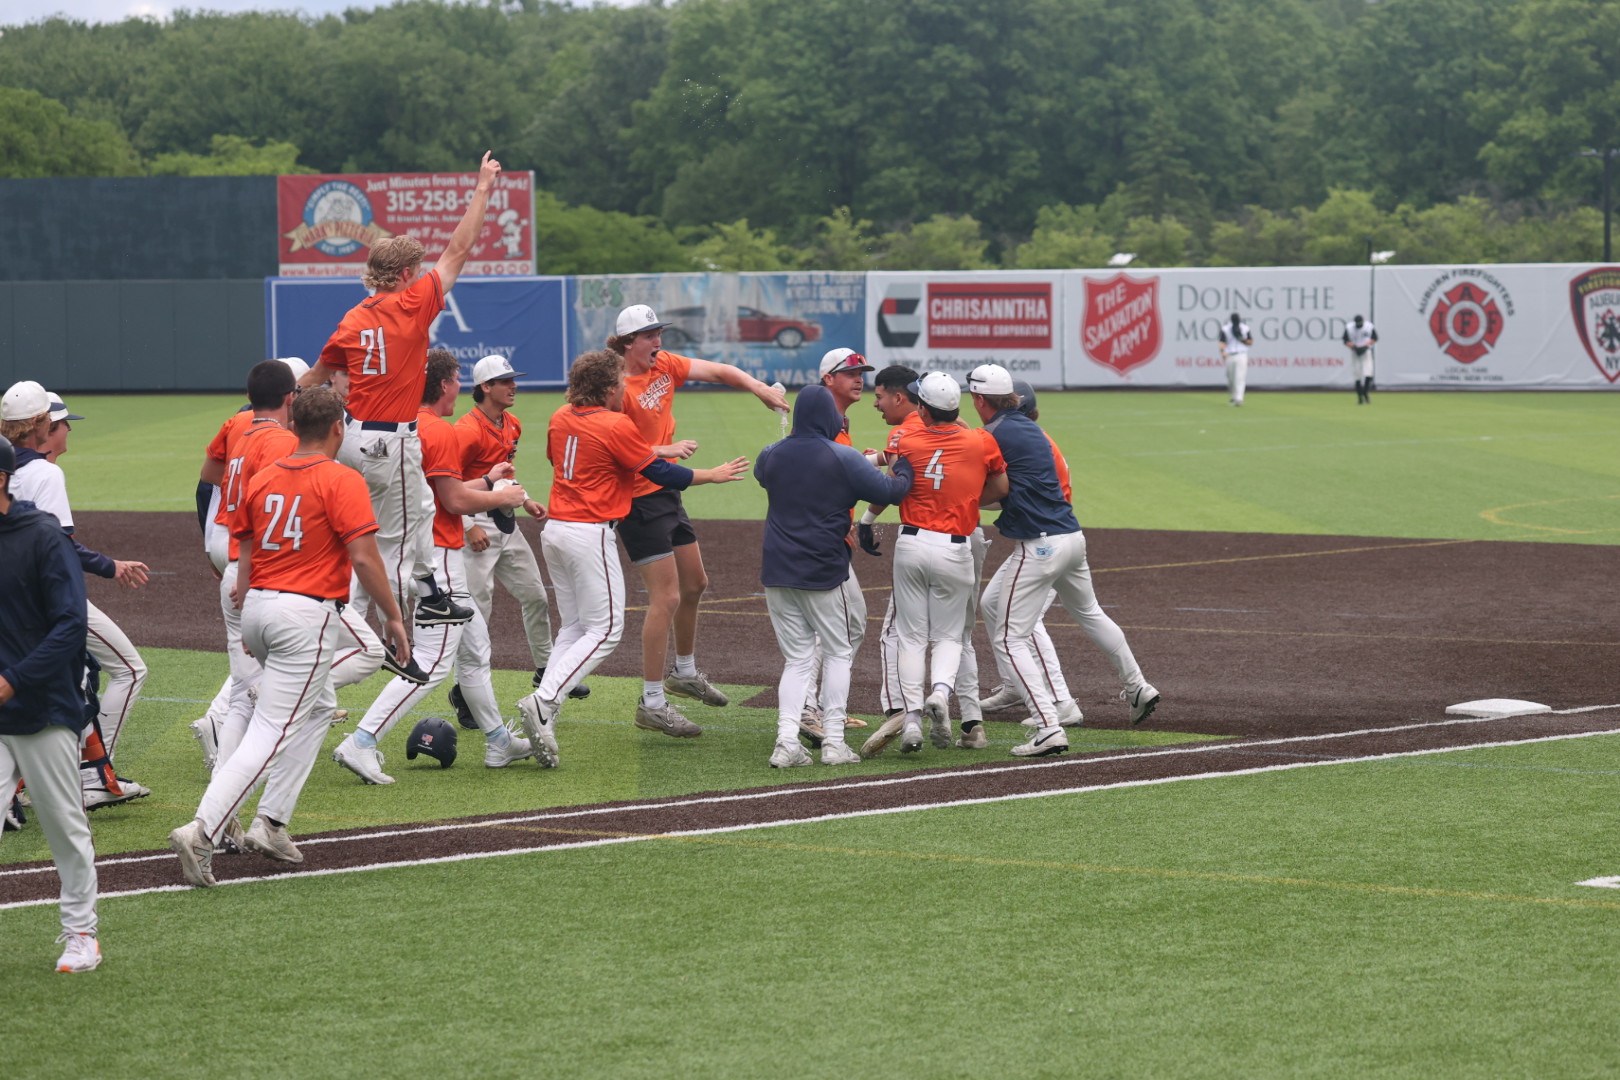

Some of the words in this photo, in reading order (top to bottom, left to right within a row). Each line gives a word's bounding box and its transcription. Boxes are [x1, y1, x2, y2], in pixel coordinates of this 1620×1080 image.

[366, 180, 387, 192] Just
[389, 175, 431, 189] Minutes
[433, 175, 456, 186] from
[459, 175, 475, 186] the
[386, 190, 508, 212] 315-258-941
[931, 298, 1048, 320] CHRISANNTHA
[1096, 282, 1126, 315] THE
[1177, 284, 1274, 312] DOING
[1281, 286, 1336, 310] THE
[1419, 273, 1450, 315] AUBURN
[1452, 269, 1514, 316] FIREFIGHTERS
[1085, 286, 1153, 350] SALVATION
[1260, 317, 1347, 341] GOOD
[359, 325, 387, 375] 21
[1109, 315, 1152, 363] ARMY
[774, 369, 821, 386] WAS
[1292, 357, 1344, 367] AUBURN
[563, 434, 578, 480] 11
[923, 449, 945, 490] 4
[261, 493, 304, 551] 24
